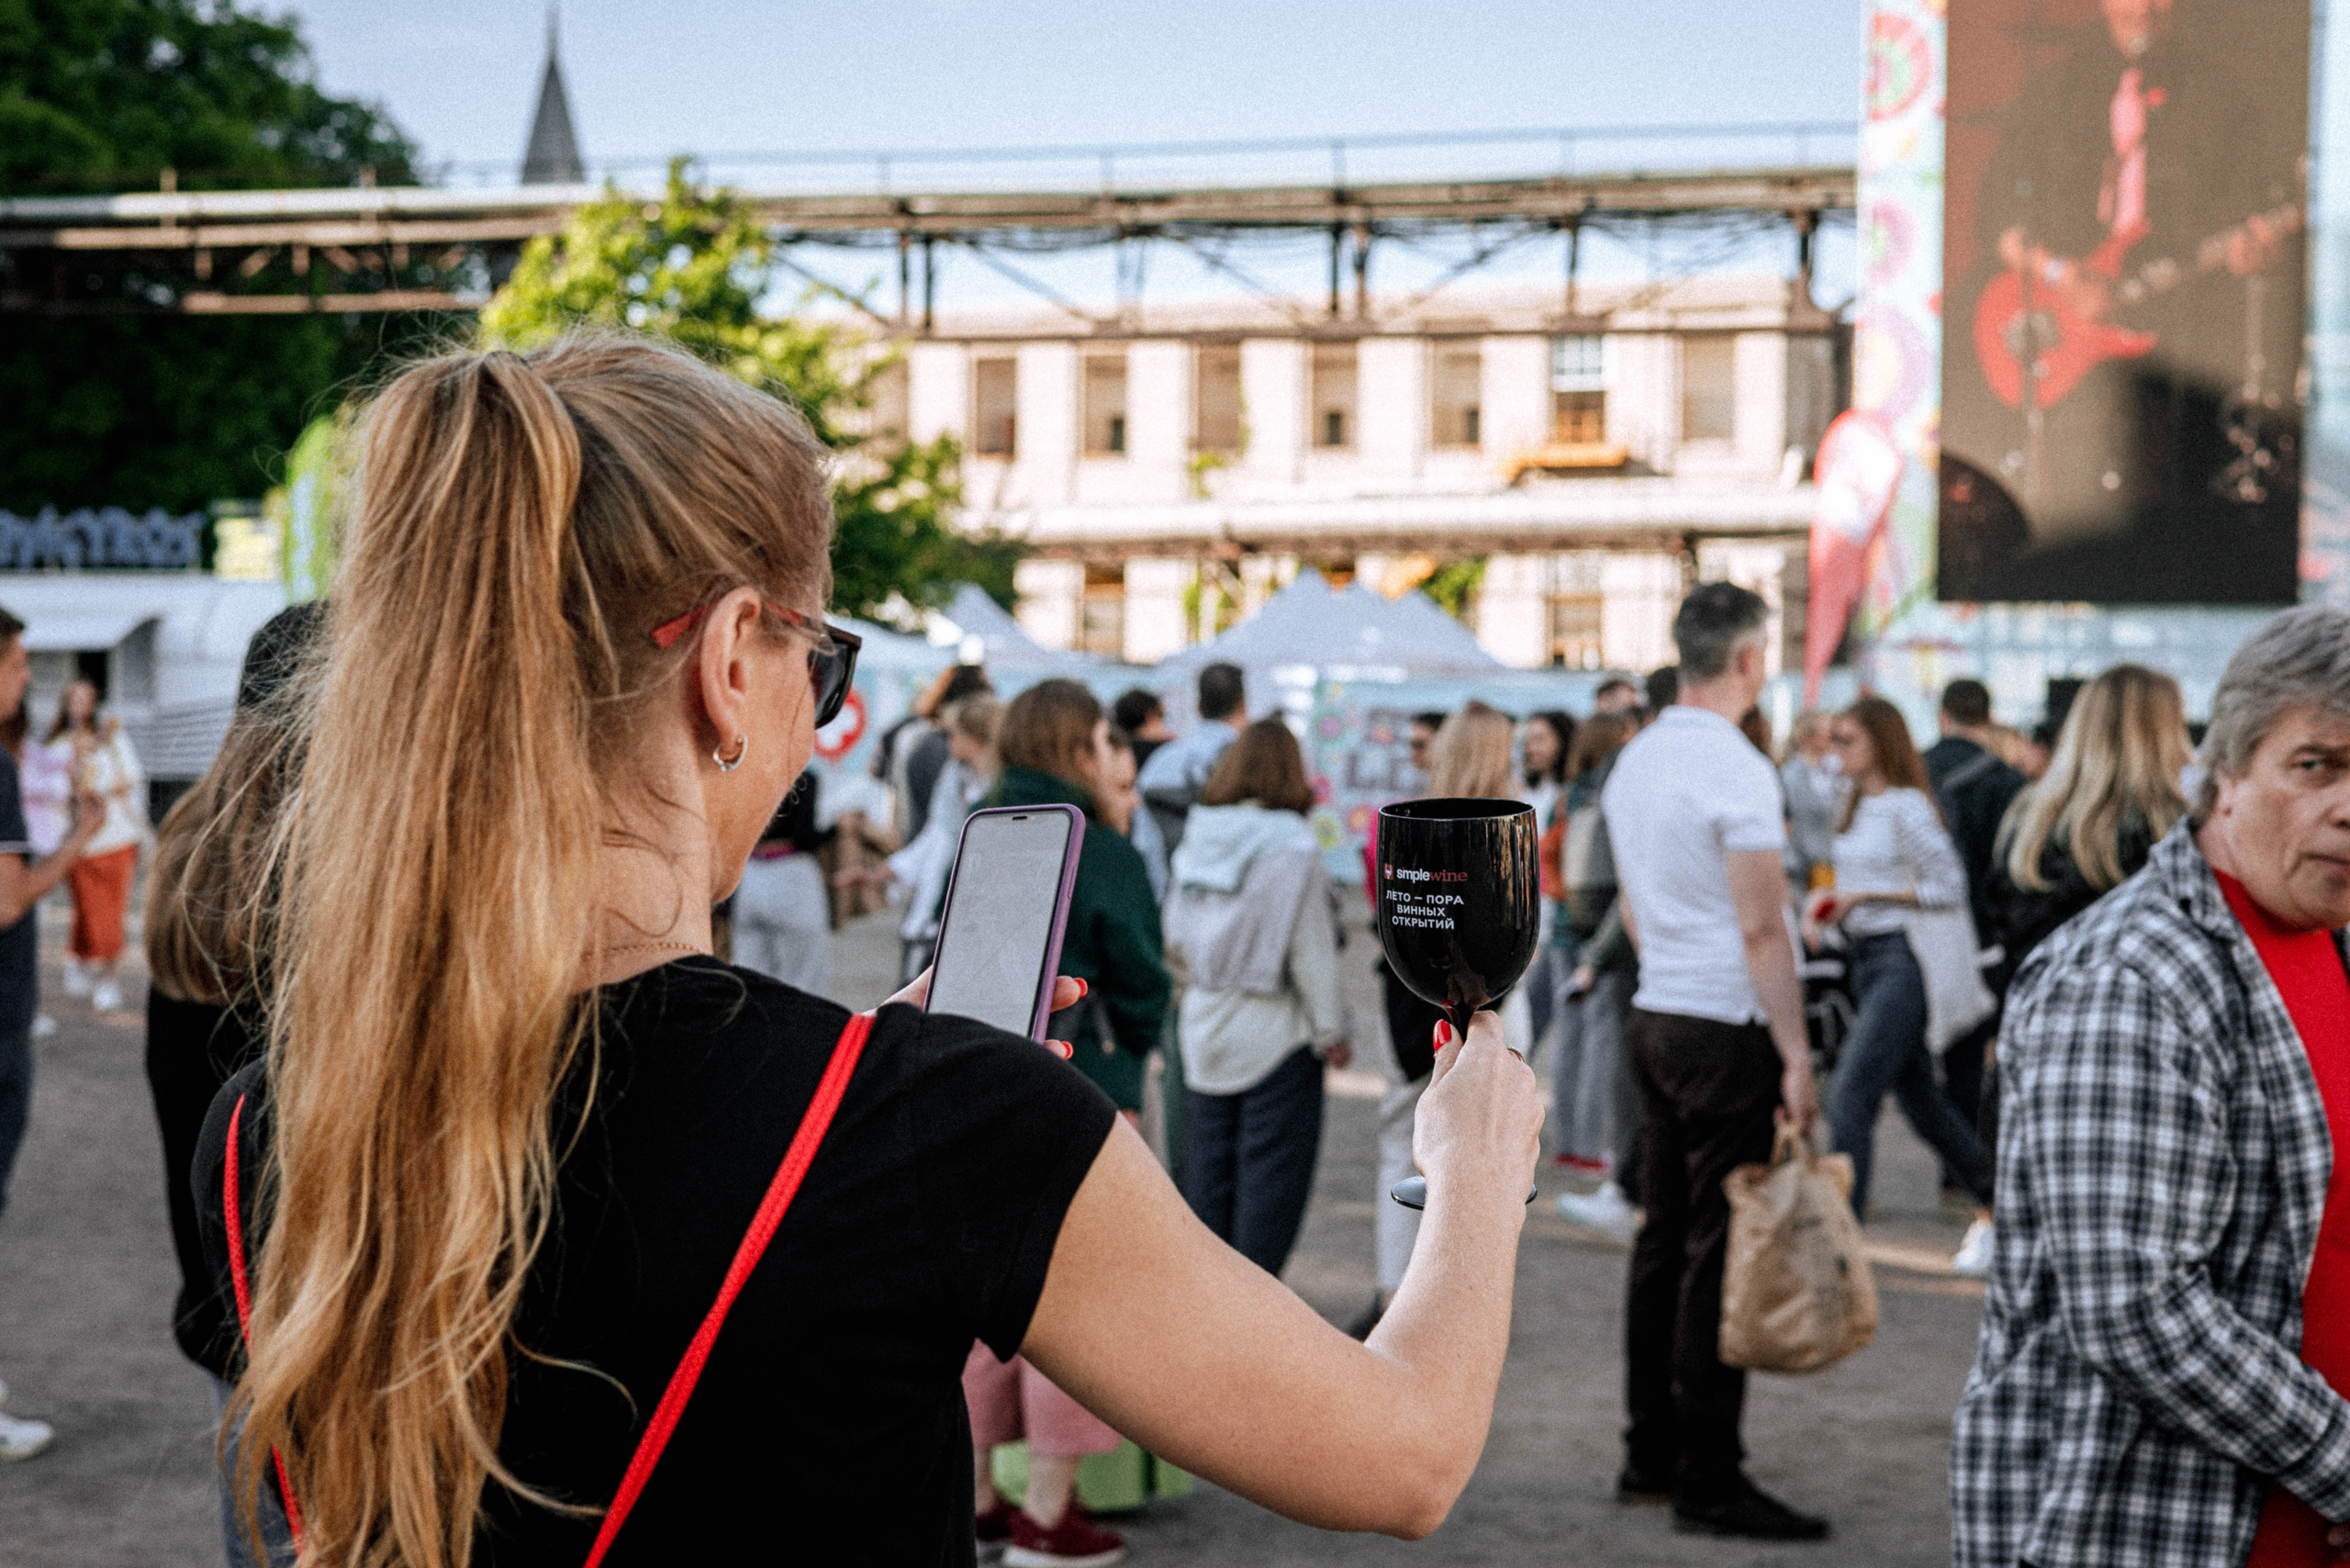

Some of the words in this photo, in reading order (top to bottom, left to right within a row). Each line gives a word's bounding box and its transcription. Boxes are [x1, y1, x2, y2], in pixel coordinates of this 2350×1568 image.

[1386, 890, 1411, 902] ЛЕТО
[1426, 894, 1464, 905] ПОРА
[1396, 903, 1446, 917] ВИННЫХ
[1392, 915, 1455, 930] ОТКРЫТИЙ
